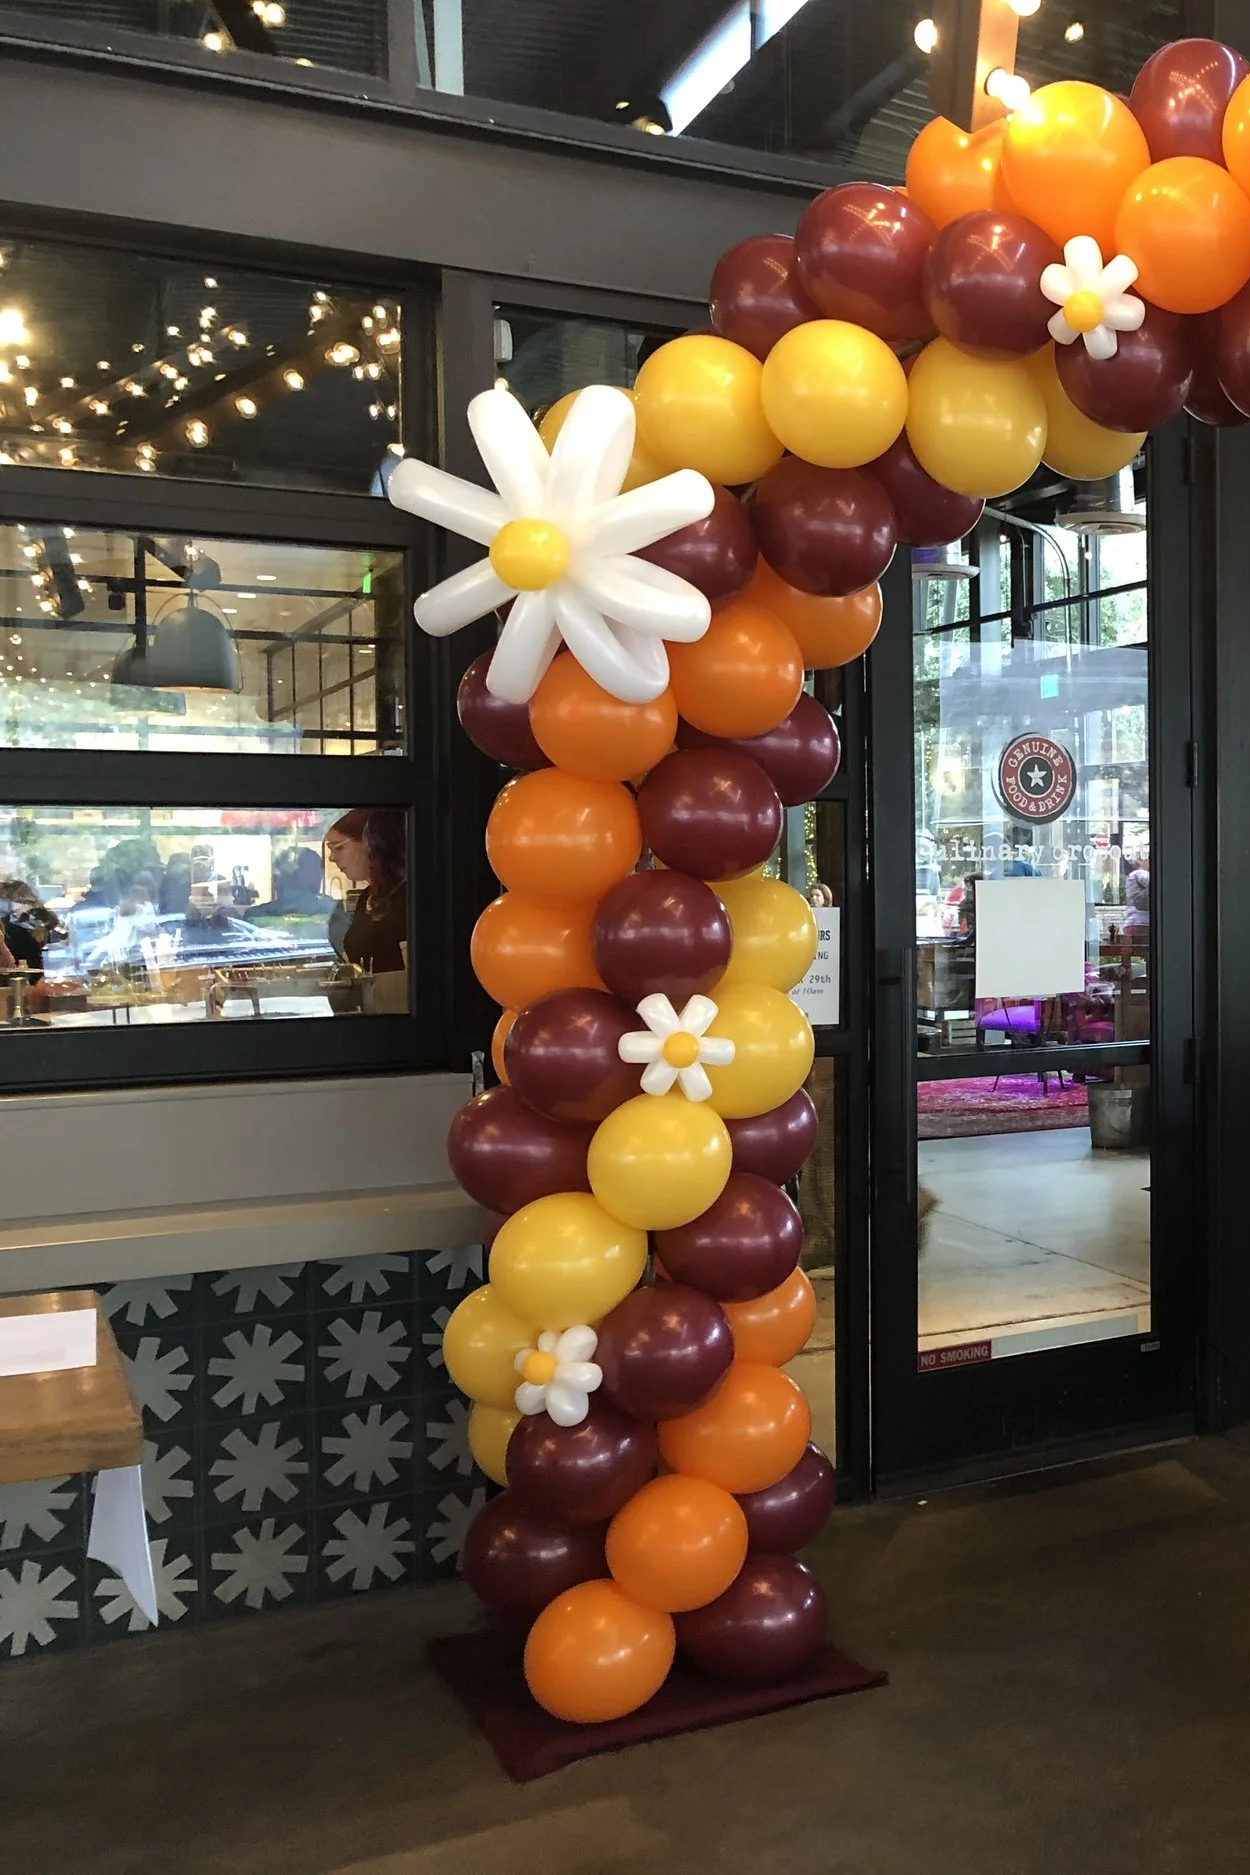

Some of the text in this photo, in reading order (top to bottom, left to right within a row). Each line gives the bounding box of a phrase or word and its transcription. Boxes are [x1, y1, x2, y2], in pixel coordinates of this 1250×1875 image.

[1008, 741, 1064, 768] GENUINE
[1006, 775, 1028, 808] FOOD
[1038, 774, 1067, 812] DRINK
[809, 974, 831, 984] 29th
[920, 1345, 989, 1367] NO SMOKING
